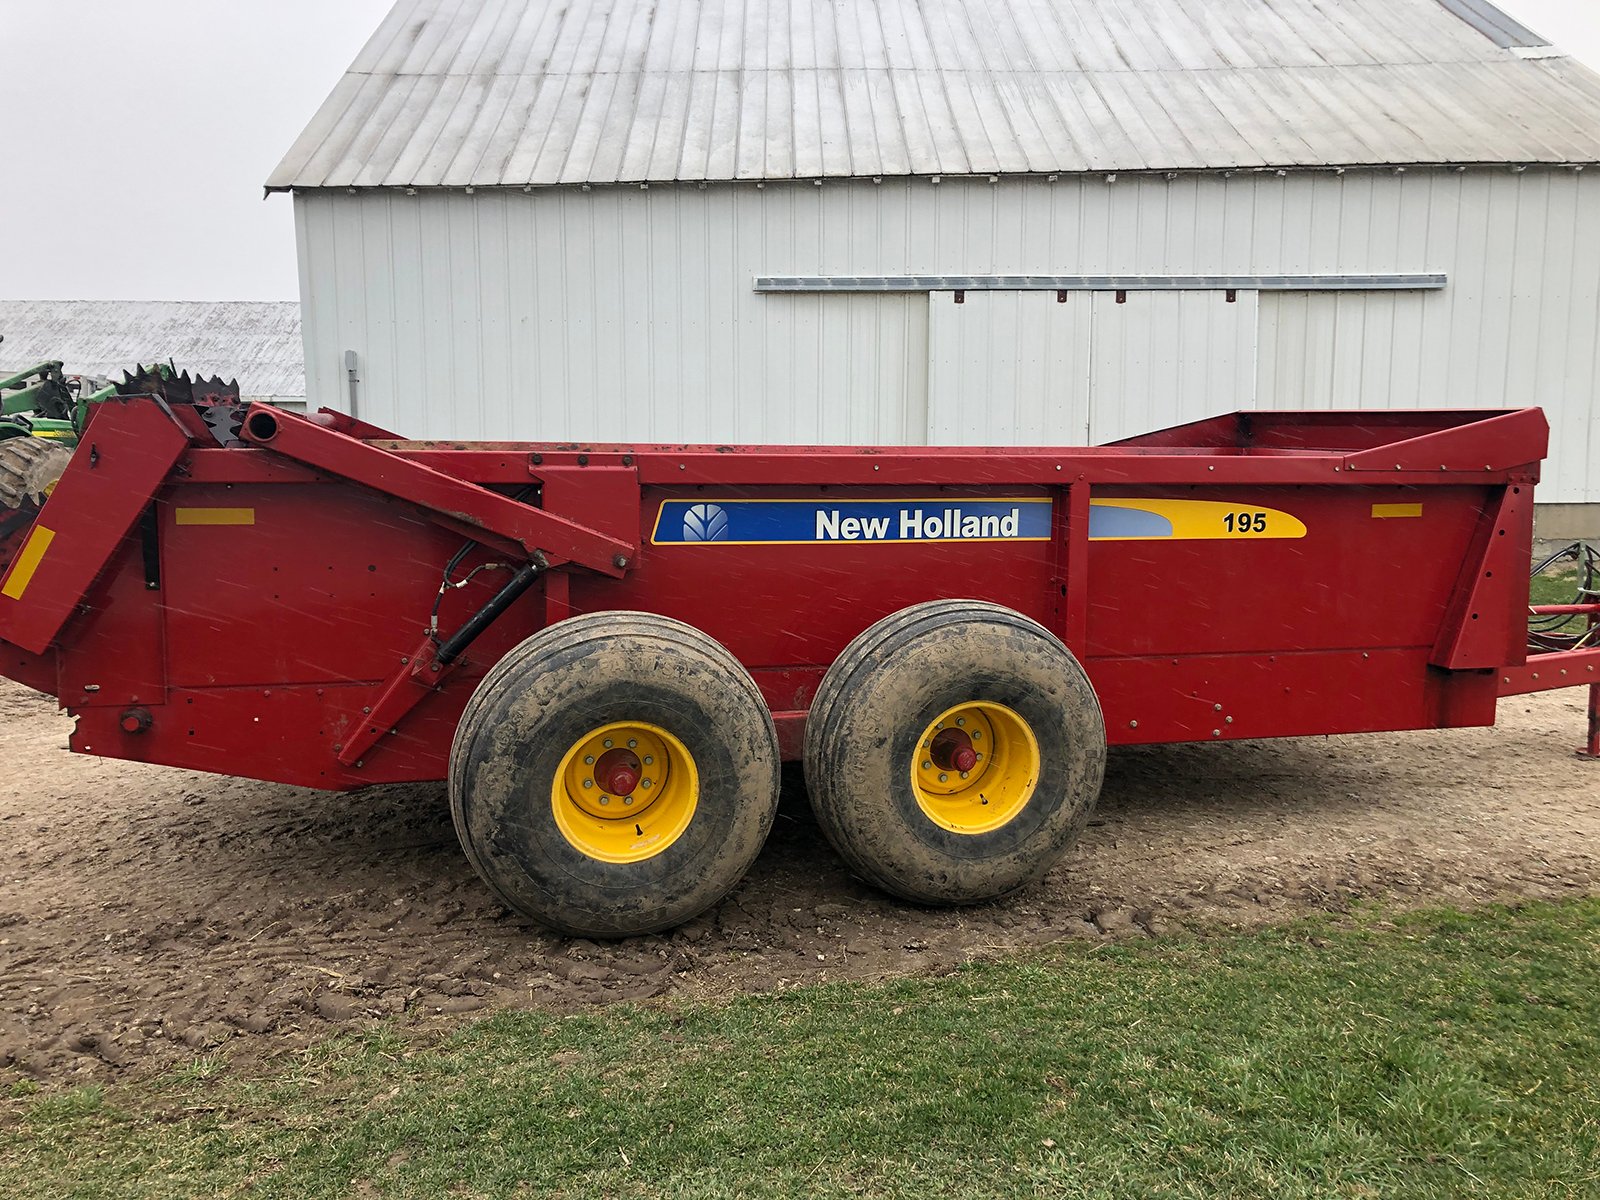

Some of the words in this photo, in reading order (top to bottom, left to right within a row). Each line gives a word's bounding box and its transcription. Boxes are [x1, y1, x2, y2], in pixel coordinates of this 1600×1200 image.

[816, 510, 890, 540] New
[900, 508, 1019, 538] Holland
[1223, 512, 1267, 533] 195
